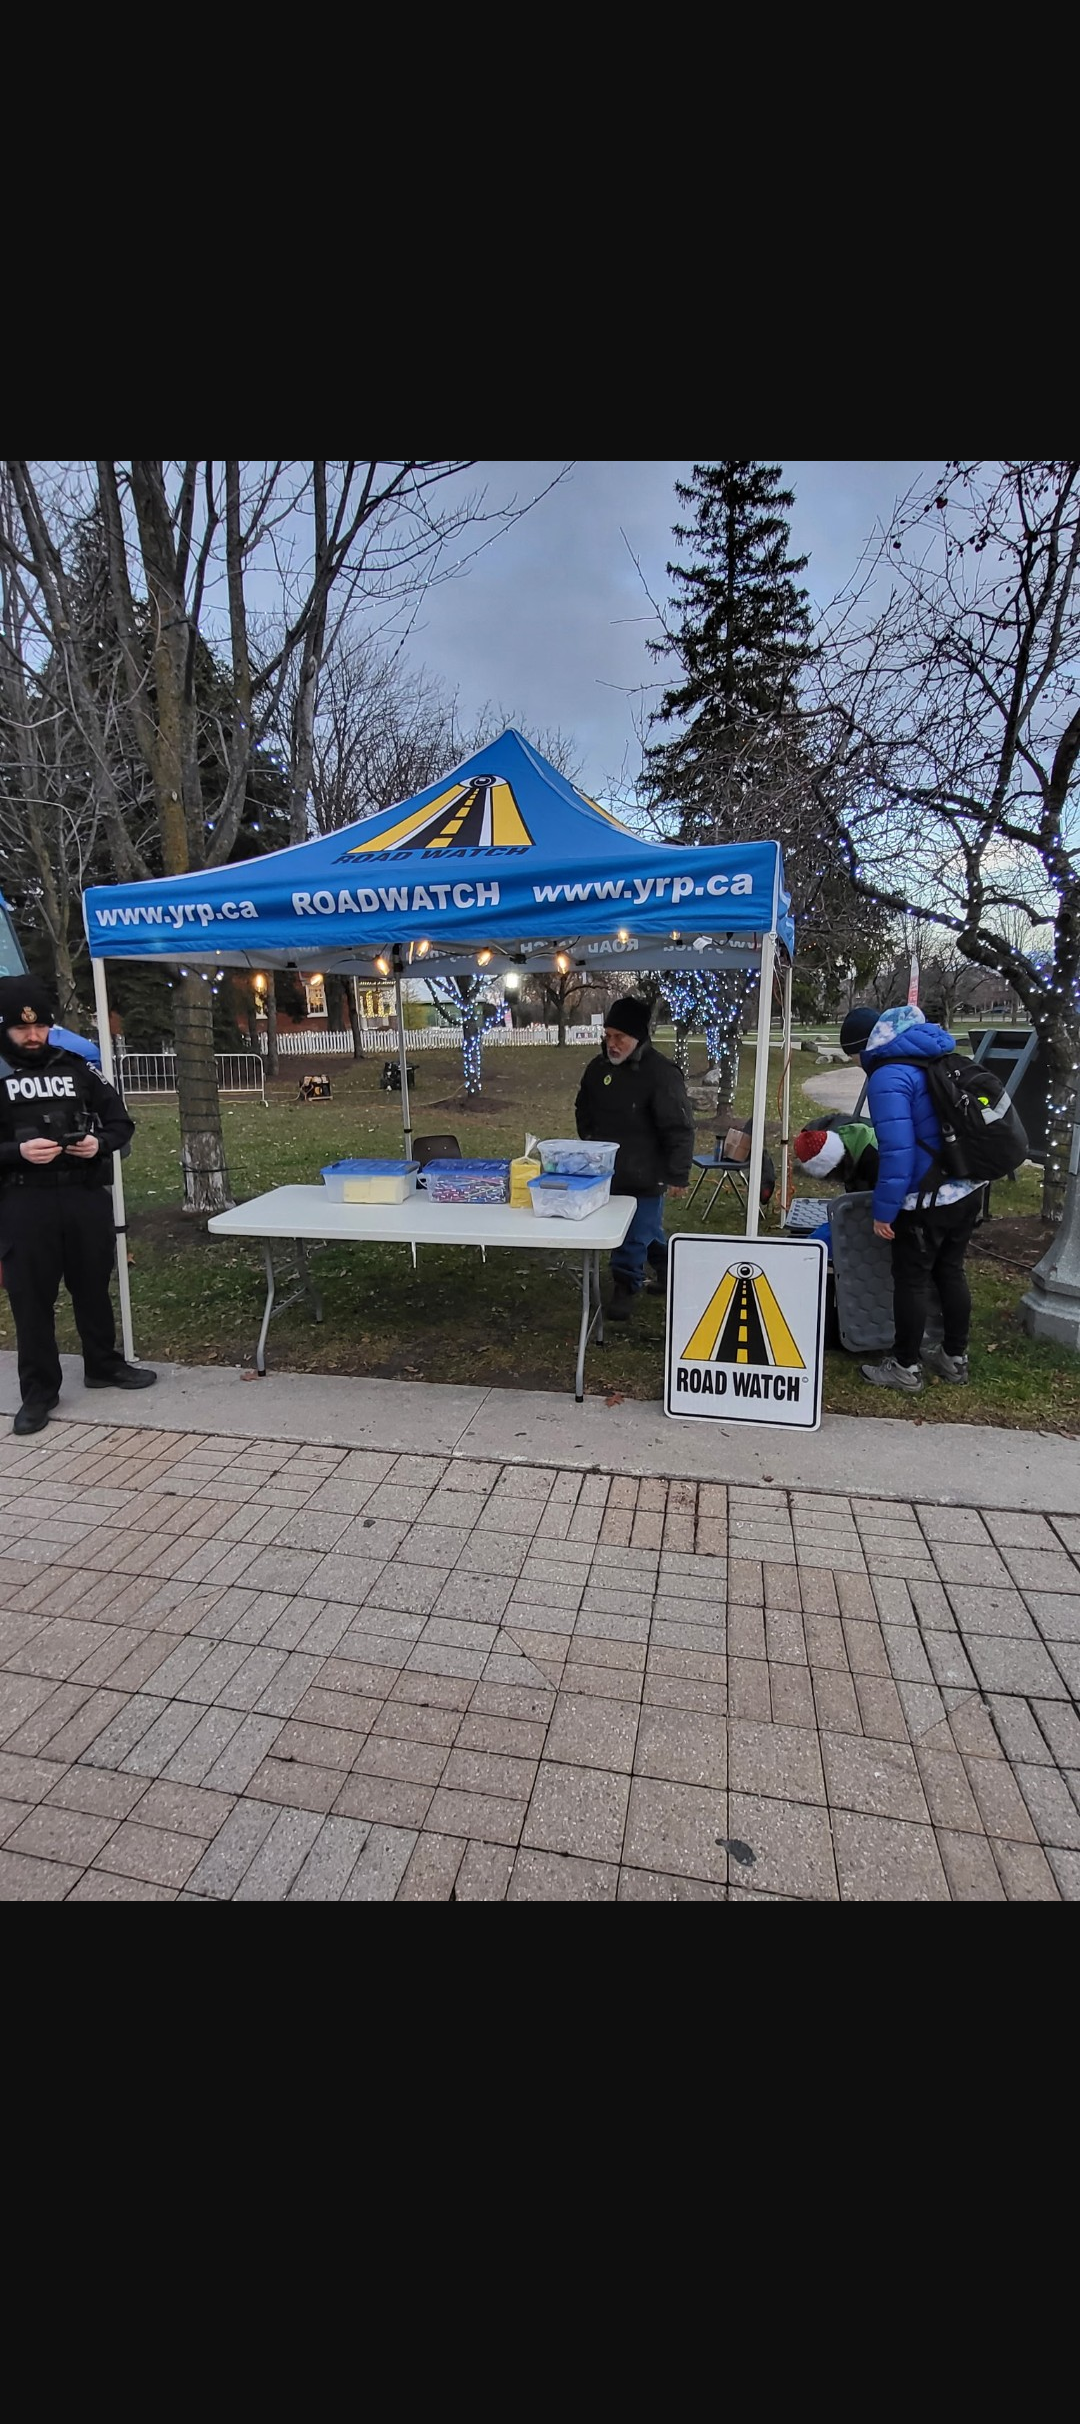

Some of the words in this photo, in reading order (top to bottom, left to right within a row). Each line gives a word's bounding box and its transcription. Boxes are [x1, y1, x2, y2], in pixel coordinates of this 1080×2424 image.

[331, 850, 414, 865] ROAD
[421, 845, 530, 860] WATCH
[95, 900, 258, 928] www.yrp.ca
[292, 882, 500, 915] ROADWATCH
[532, 872, 754, 904] www.yrp.ca
[5, 1076, 77, 1101] POLICE
[676, 1367, 727, 1395] ROAD
[732, 1370, 800, 1402] WATCH
